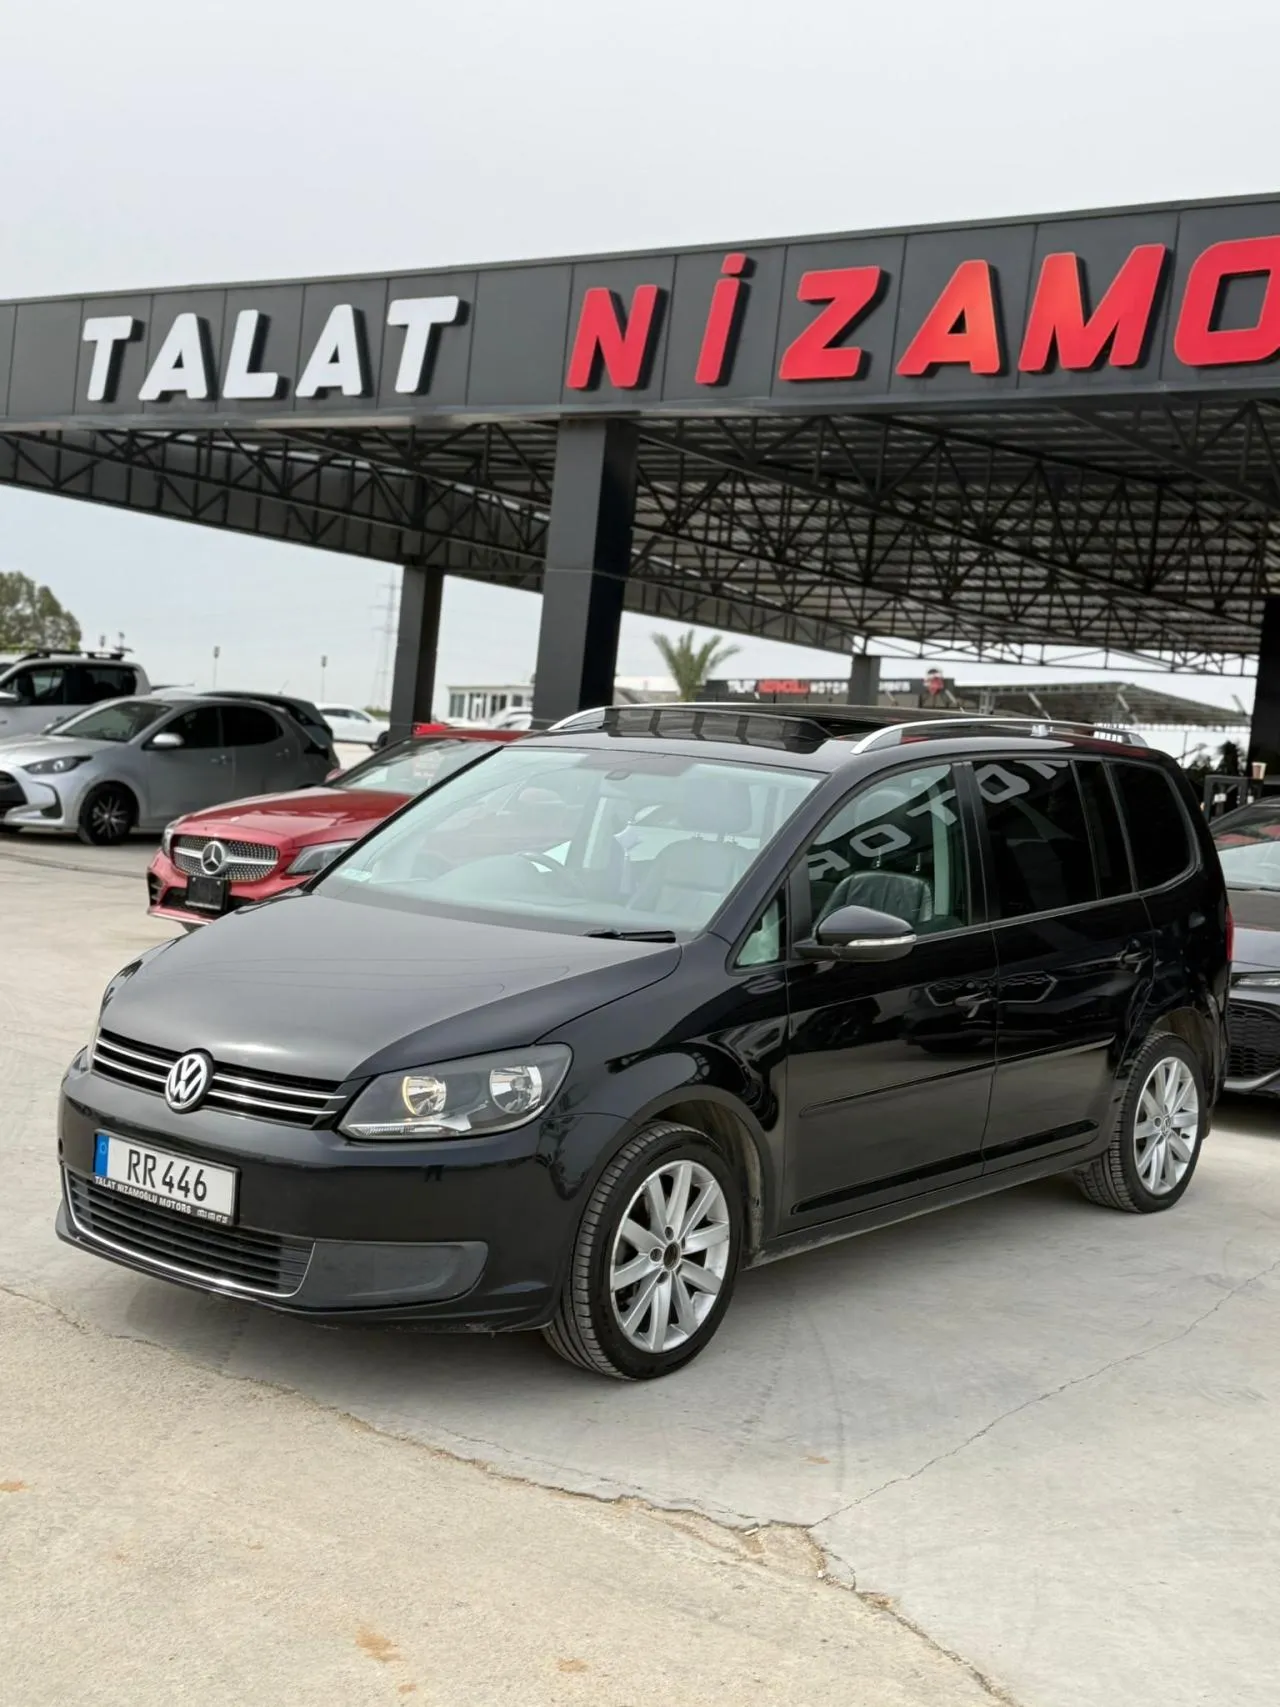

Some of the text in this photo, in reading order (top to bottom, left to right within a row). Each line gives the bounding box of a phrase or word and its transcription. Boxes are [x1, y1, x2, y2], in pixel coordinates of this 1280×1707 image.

[82, 295, 459, 401] TALAT
[95, 1176, 117, 1190] TALAT
[159, 1197, 191, 1214] MOTORS
[127, 1148, 207, 1202] RR 446
